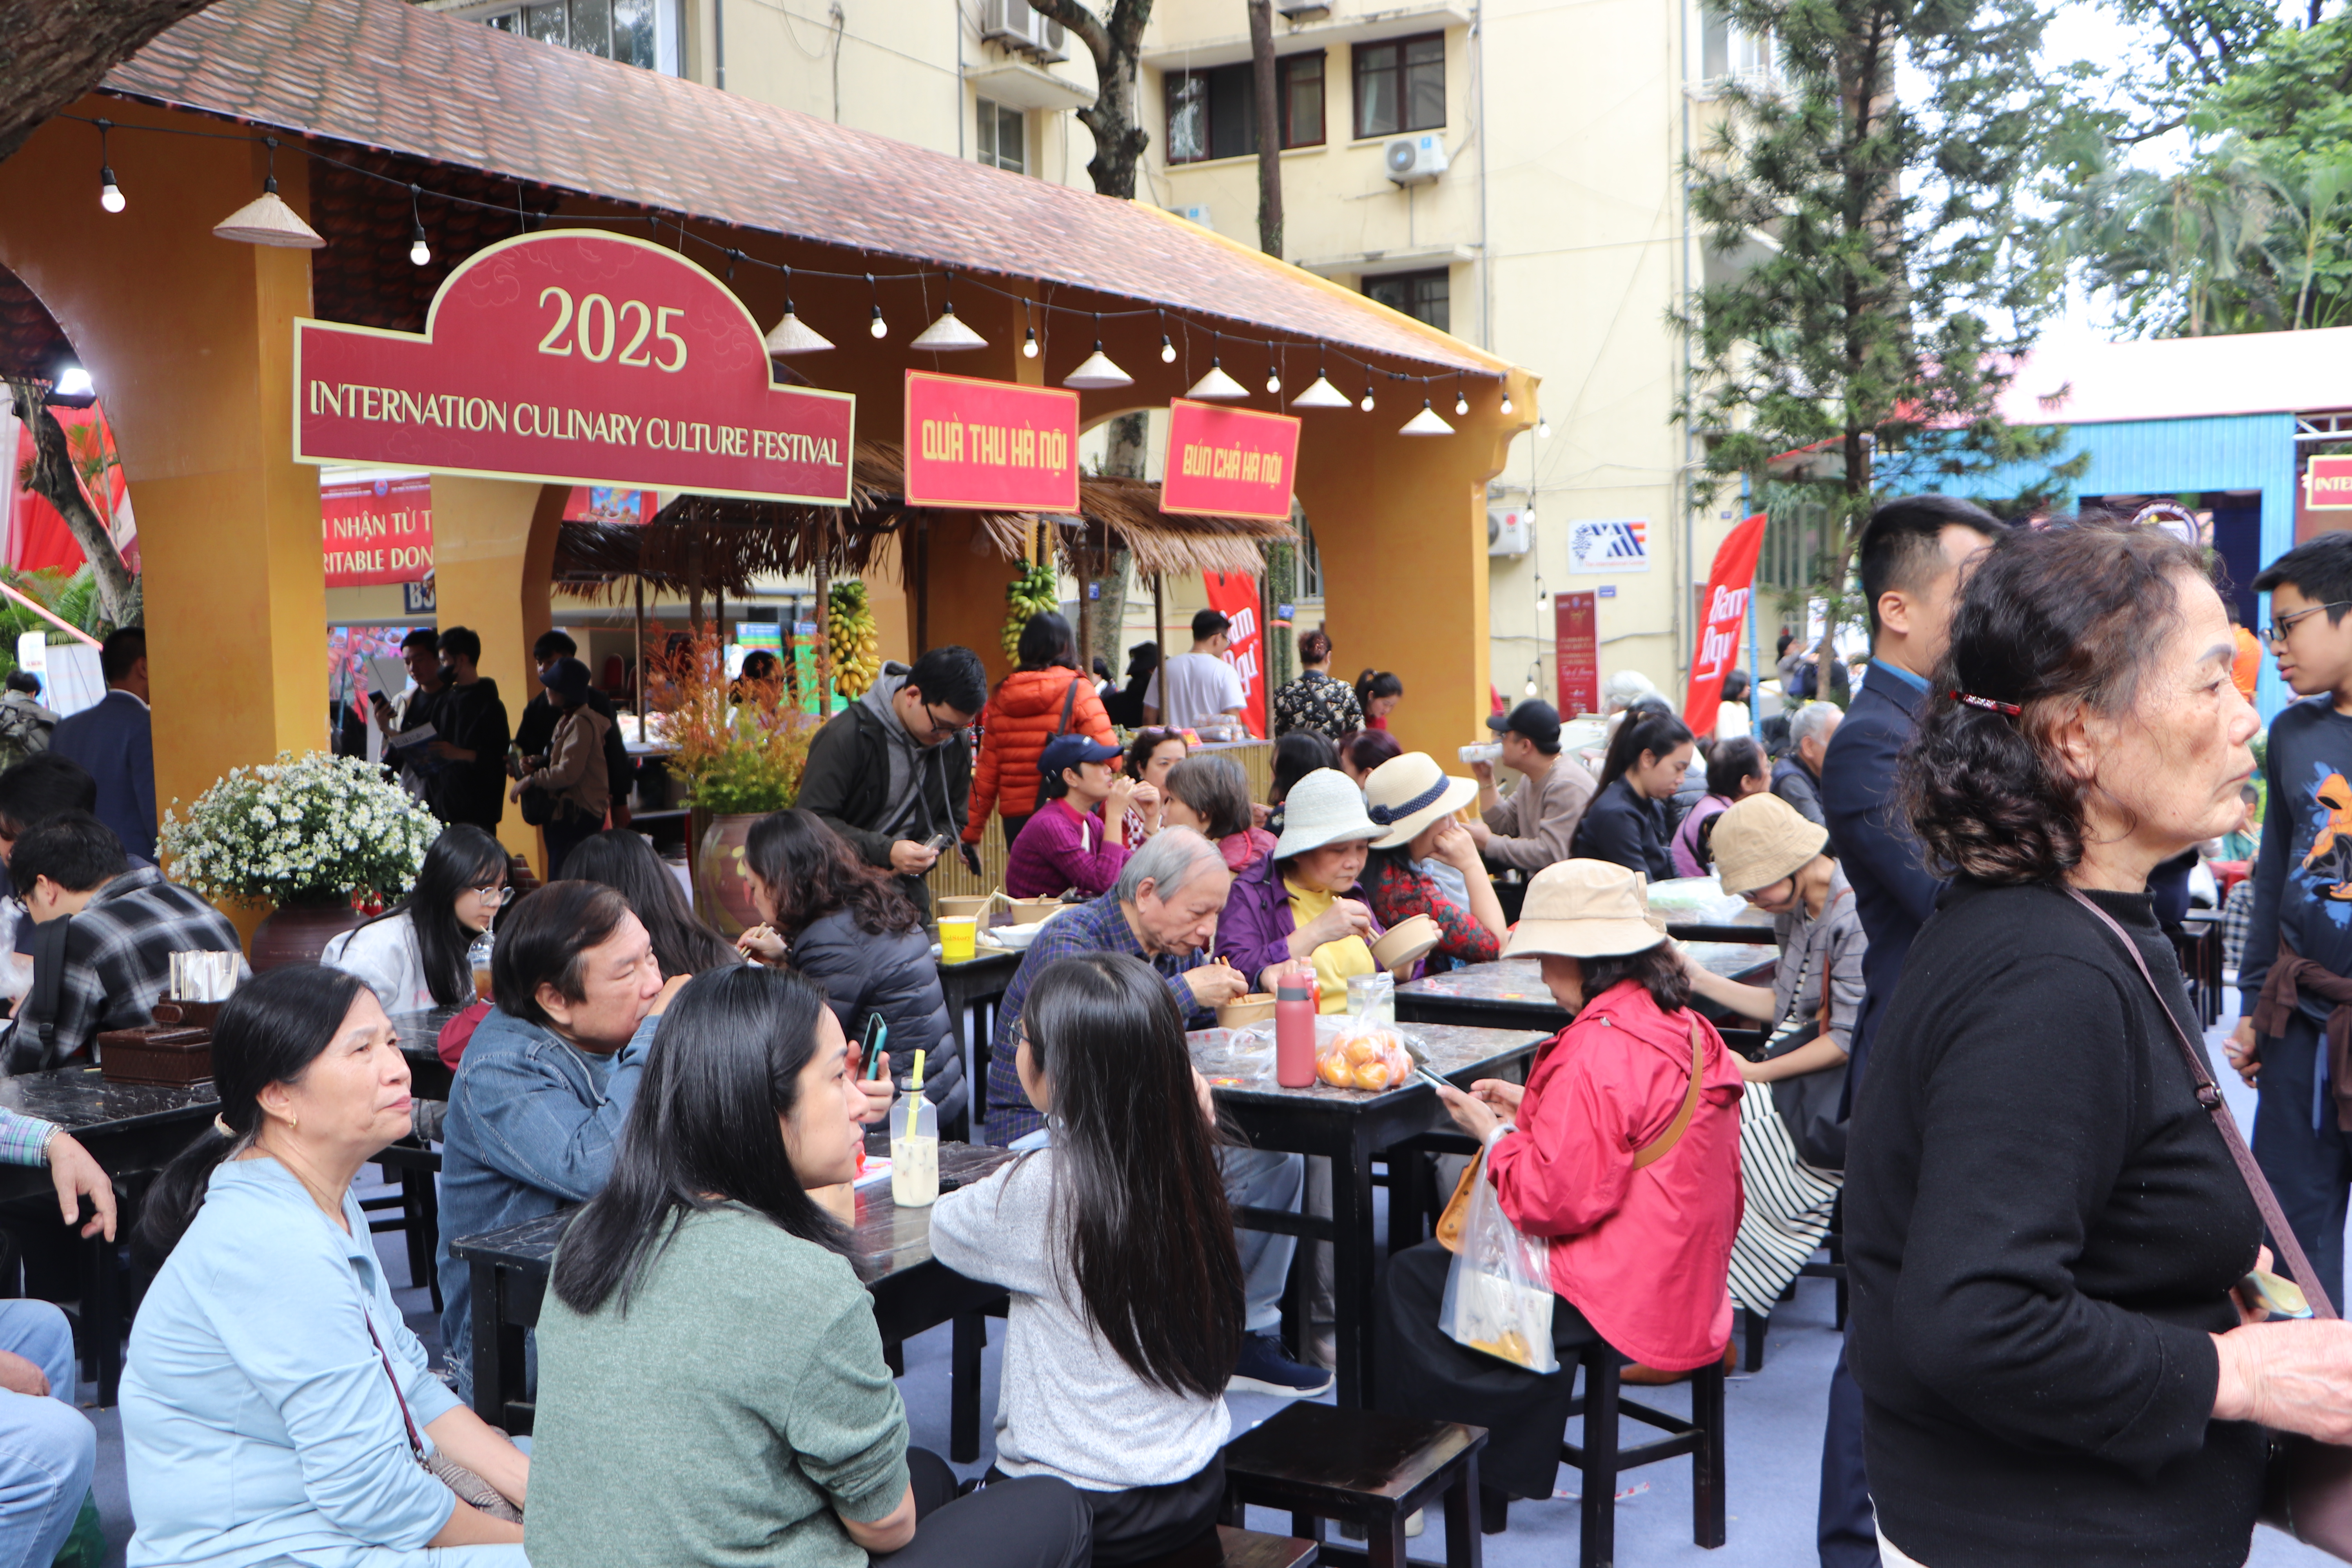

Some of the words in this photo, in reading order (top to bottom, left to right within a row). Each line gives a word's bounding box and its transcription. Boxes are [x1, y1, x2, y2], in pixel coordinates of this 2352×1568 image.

[538, 286, 688, 373] 2025
[310, 379, 507, 434] INTERNATION
[513, 403, 643, 446] CULINARY
[646, 417, 749, 458] CULTURE
[753, 429, 844, 467] FESTIVAL
[922, 412, 964, 463] QUÀ
[968, 423, 1007, 466] THU
[1011, 419, 1035, 468] HÀ
[1039, 428, 1067, 477] NỘI
[1182, 439, 1212, 477] BÚN
[1213, 441, 1241, 479] CHẢ
[1241, 444, 1261, 482] HÀ
[1261, 451, 1283, 489] NỘI
[2315, 476, 2352, 492] INTE
[334, 510, 386, 542] NHẬN
[391, 506, 416, 535] TỪ
[421, 510, 432, 532] T
[323, 549, 384, 573] RITABLE
[391, 545, 434, 570] DON
